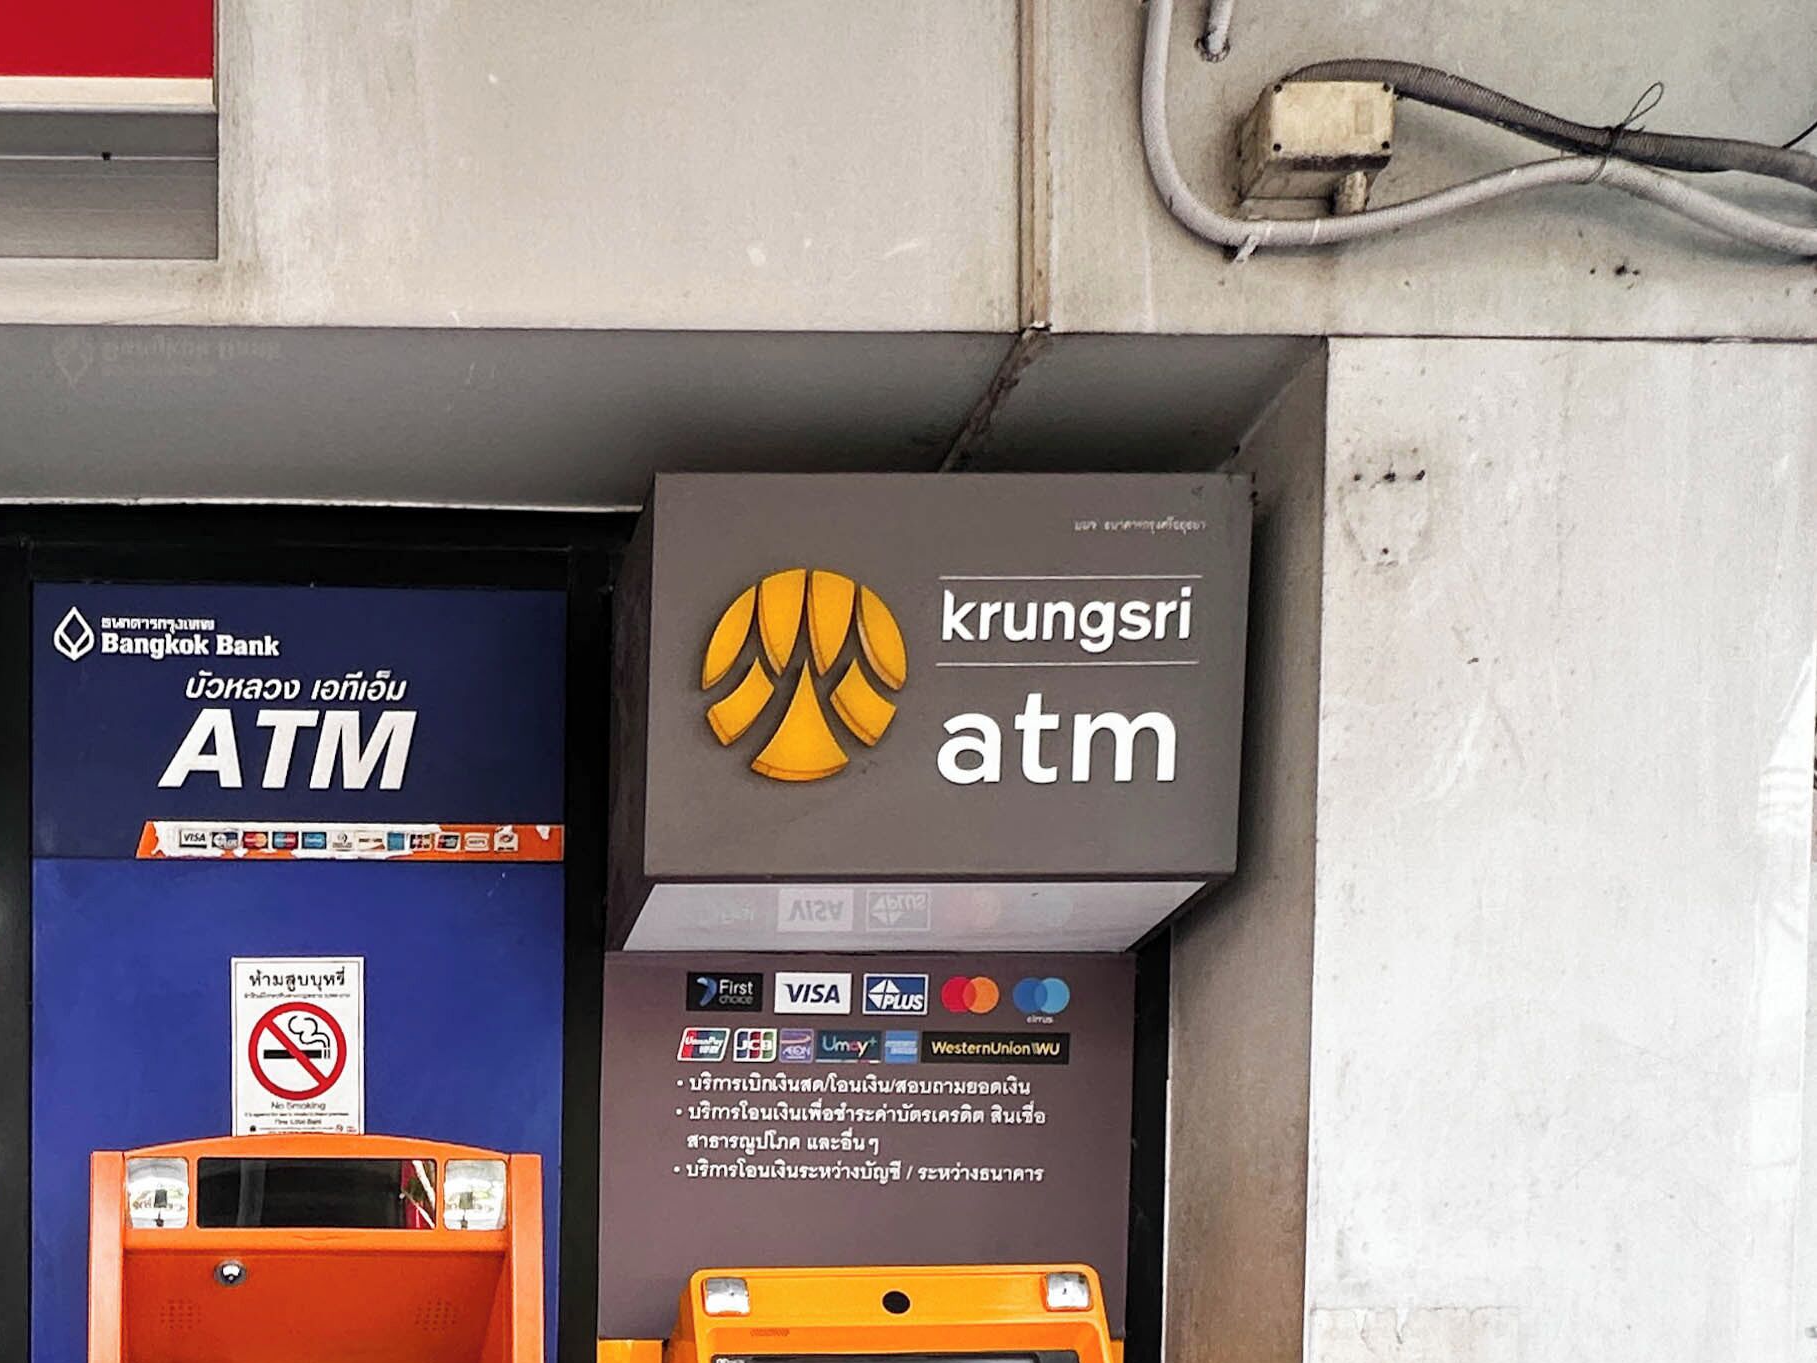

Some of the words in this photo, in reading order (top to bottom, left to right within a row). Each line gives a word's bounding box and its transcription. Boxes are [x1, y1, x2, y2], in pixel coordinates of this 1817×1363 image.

[942, 586, 1192, 653] krungsri
[101, 632, 210, 660] Bangkok
[216, 635, 280, 656] Bank
[185, 669, 301, 700] บัวหลวง
[311, 670, 407, 701] เอทีเอ็ม
[157, 708, 418, 790] ATM
[937, 693, 1177, 785] atm
[183, 832, 207, 842] VISA
[249, 966, 345, 992] ห้ามสูบบุหรี่
[719, 980, 753, 995] First
[784, 984, 841, 1003] VISA
[882, 993, 924, 1011] PLUS
[736, 1037, 773, 1051] JCB
[931, 1040, 1031, 1056] WesternUnion
